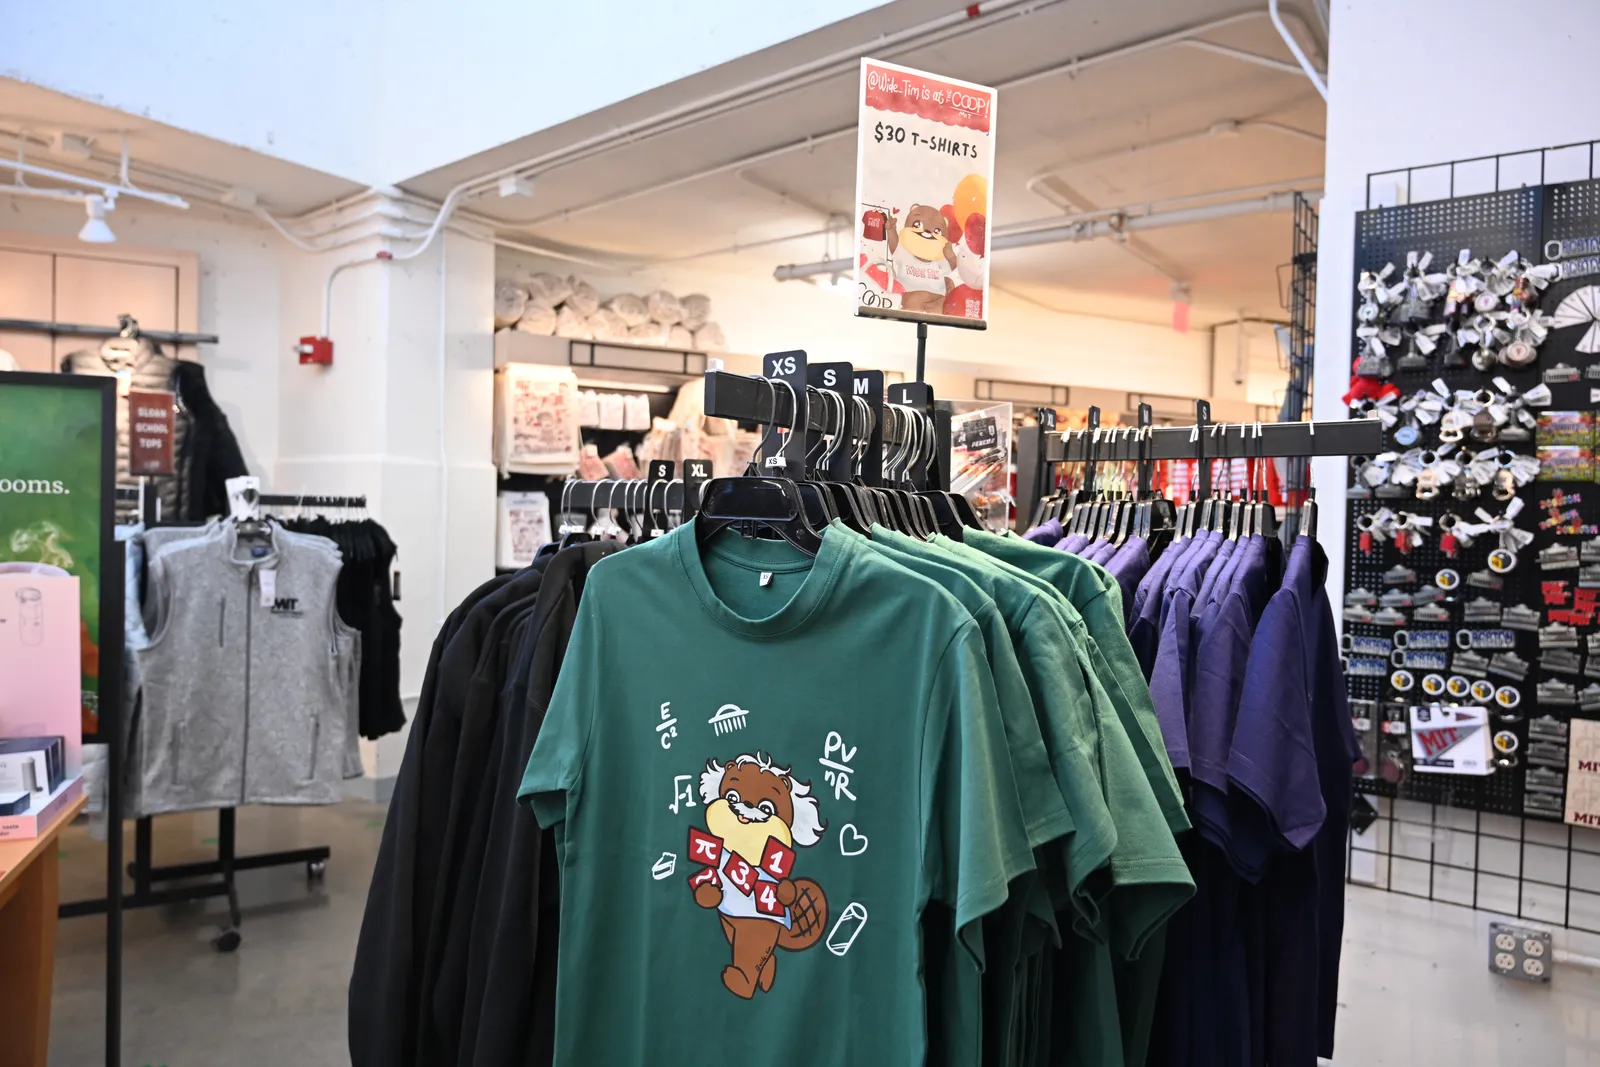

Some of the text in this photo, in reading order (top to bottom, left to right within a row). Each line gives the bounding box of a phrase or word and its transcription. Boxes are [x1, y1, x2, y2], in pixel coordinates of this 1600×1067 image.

[867, 70, 919, 100] @Wide_Tim
[921, 85, 930, 100] is
[932, 90, 944, 105] at
[874, 121, 978, 158] $30 T-SHIRTS
[906, 264, 940, 280] WIDE TIM
[772, 357, 797, 377] XS
[823, 369, 837, 387] S
[853, 378, 869, 395] M
[902, 389, 913, 404] L
[1046, 413, 1055, 428] XL
[1092, 412, 1098, 425] L
[1202, 406, 1208, 421] S
[135, 422, 169, 434] SCHOOL
[140, 438, 162, 449] TOPS
[657, 464, 667, 478] S
[691, 463, 708, 478] XL
[0, 478, 70, 494] ooms.
[661, 701, 671, 720] E
[1417, 727, 1459, 756] MIT
[1578, 760, 1600, 772] MI
[770, 850, 783, 874] 1
[760, 885, 777, 911] 4
